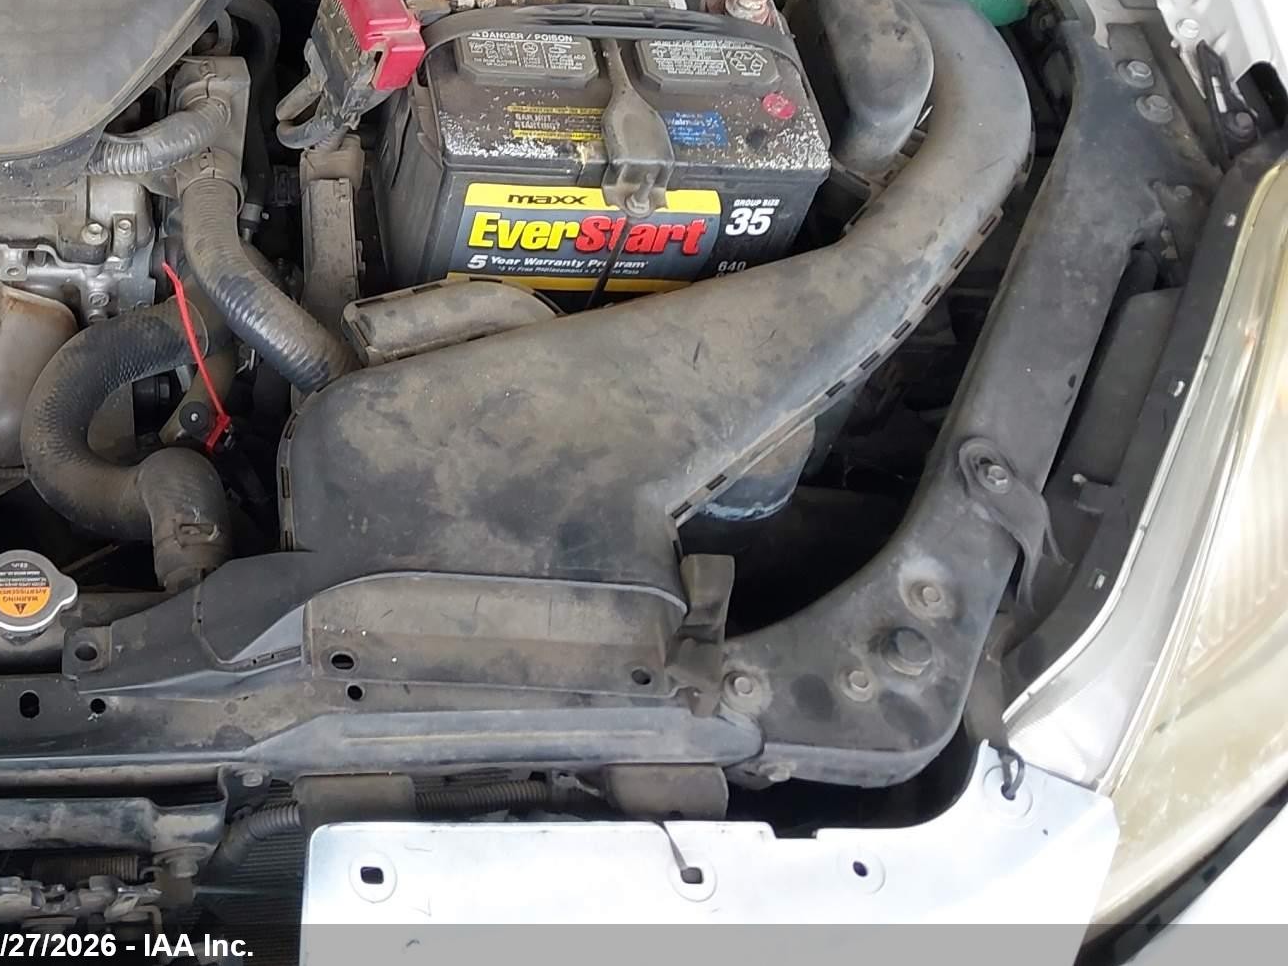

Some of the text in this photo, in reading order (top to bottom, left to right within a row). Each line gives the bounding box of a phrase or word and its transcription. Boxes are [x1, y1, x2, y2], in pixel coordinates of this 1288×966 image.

[481, 31, 524, 40] DANGER
[534, 34, 573, 42] POISON
[733, 199, 780, 207] GROUP SIZE
[725, 207, 775, 236] 35
[467, 254, 489, 269] 5
[491, 256, 521, 266] Year
[524, 257, 585, 268] Warranty
[718, 261, 747, 273] 640
